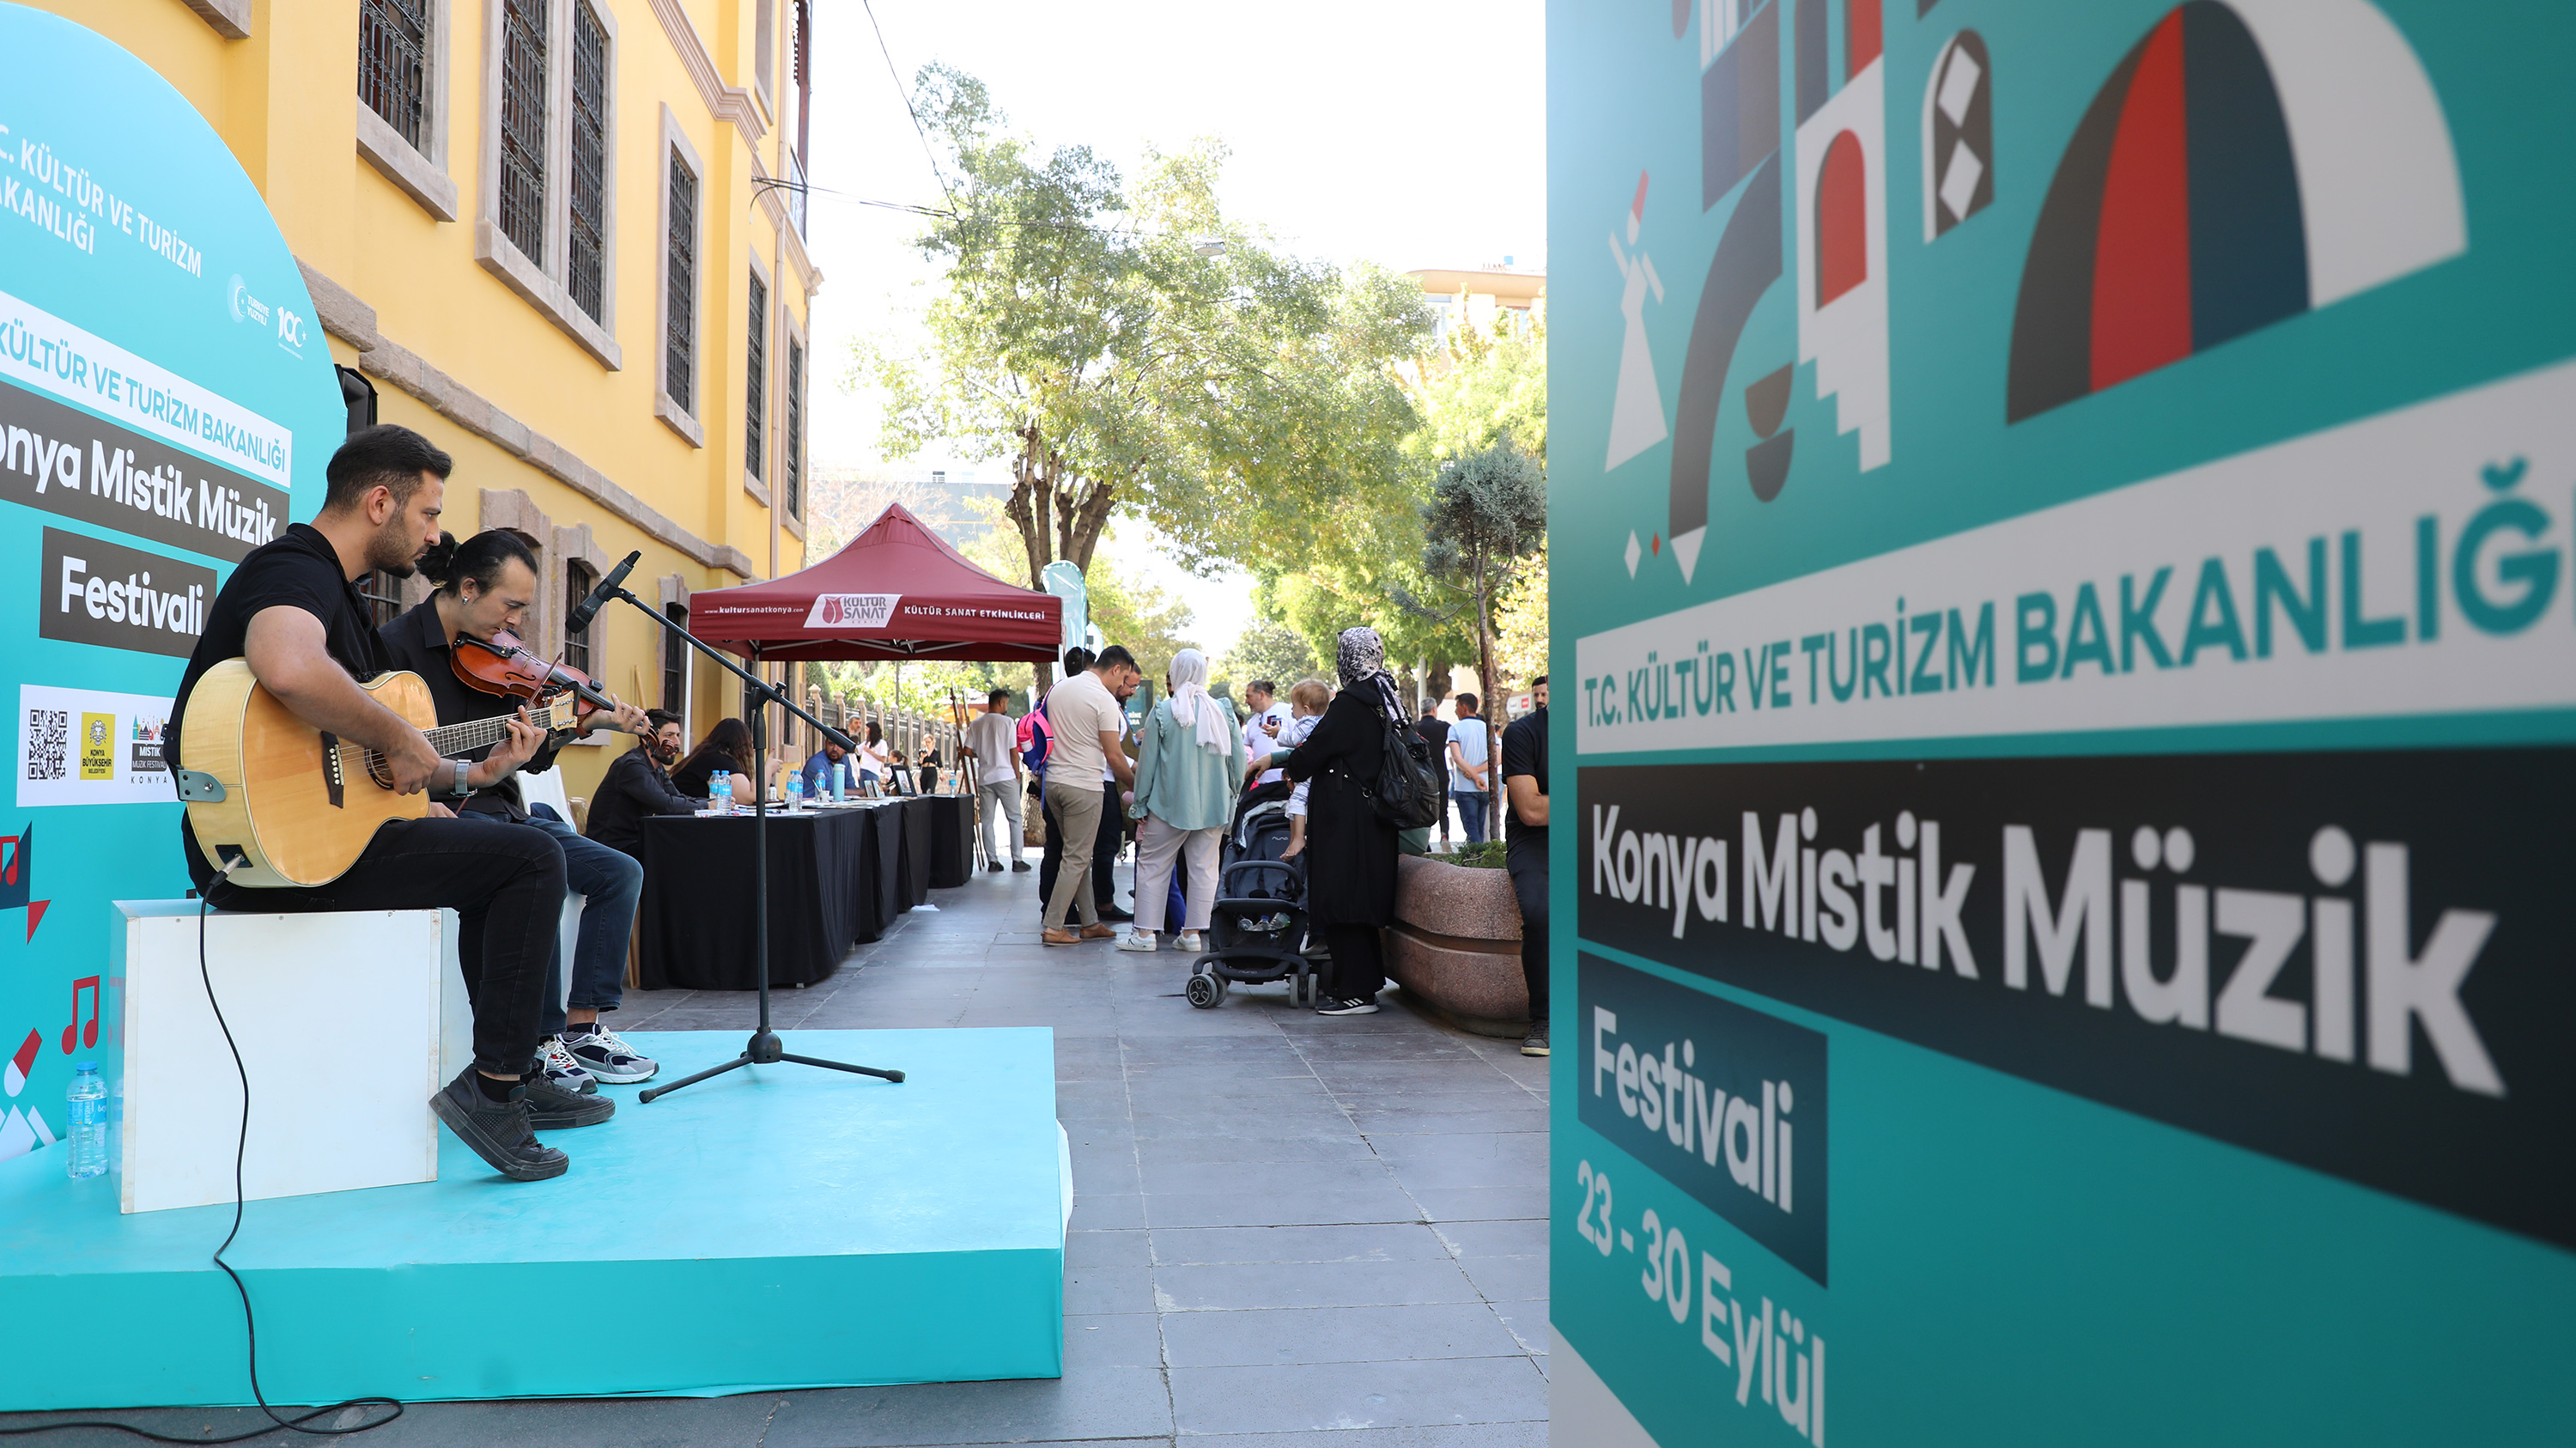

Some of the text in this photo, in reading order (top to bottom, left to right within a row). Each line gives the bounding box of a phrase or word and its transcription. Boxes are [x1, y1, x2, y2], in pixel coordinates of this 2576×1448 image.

[0, 174, 94, 255] KANLIĞI
[21, 137, 104, 218] KÜLTÜR
[109, 193, 133, 235] VE
[137, 211, 202, 278] TURİZM
[92, 361, 121, 403] VE
[125, 375, 198, 435] TURİZM
[202, 412, 287, 473] BAKANLIĞI
[0, 423, 276, 546] nya Mistik Müzik
[60, 554, 204, 637] Festivali
[704, 605, 805, 615] www.kultursanatkonya.com
[843, 607, 887, 619] SANAT
[904, 605, 1045, 620] KÜLTÜR SANAT ETKİNLİKLERİ
[1583, 457, 2576, 728] T.C. KÜLTÜR VE TURİZM BAKANLIĞ
[82, 757, 112, 768] BÜYÜKŞEHİR
[131, 776, 167, 784] KONYA
[1592, 803, 2507, 1098] Konya Mistik Müzik
[1593, 1005, 1794, 1215] Festivali
[1577, 1159, 1826, 1448] 23 - 30 Eylül
